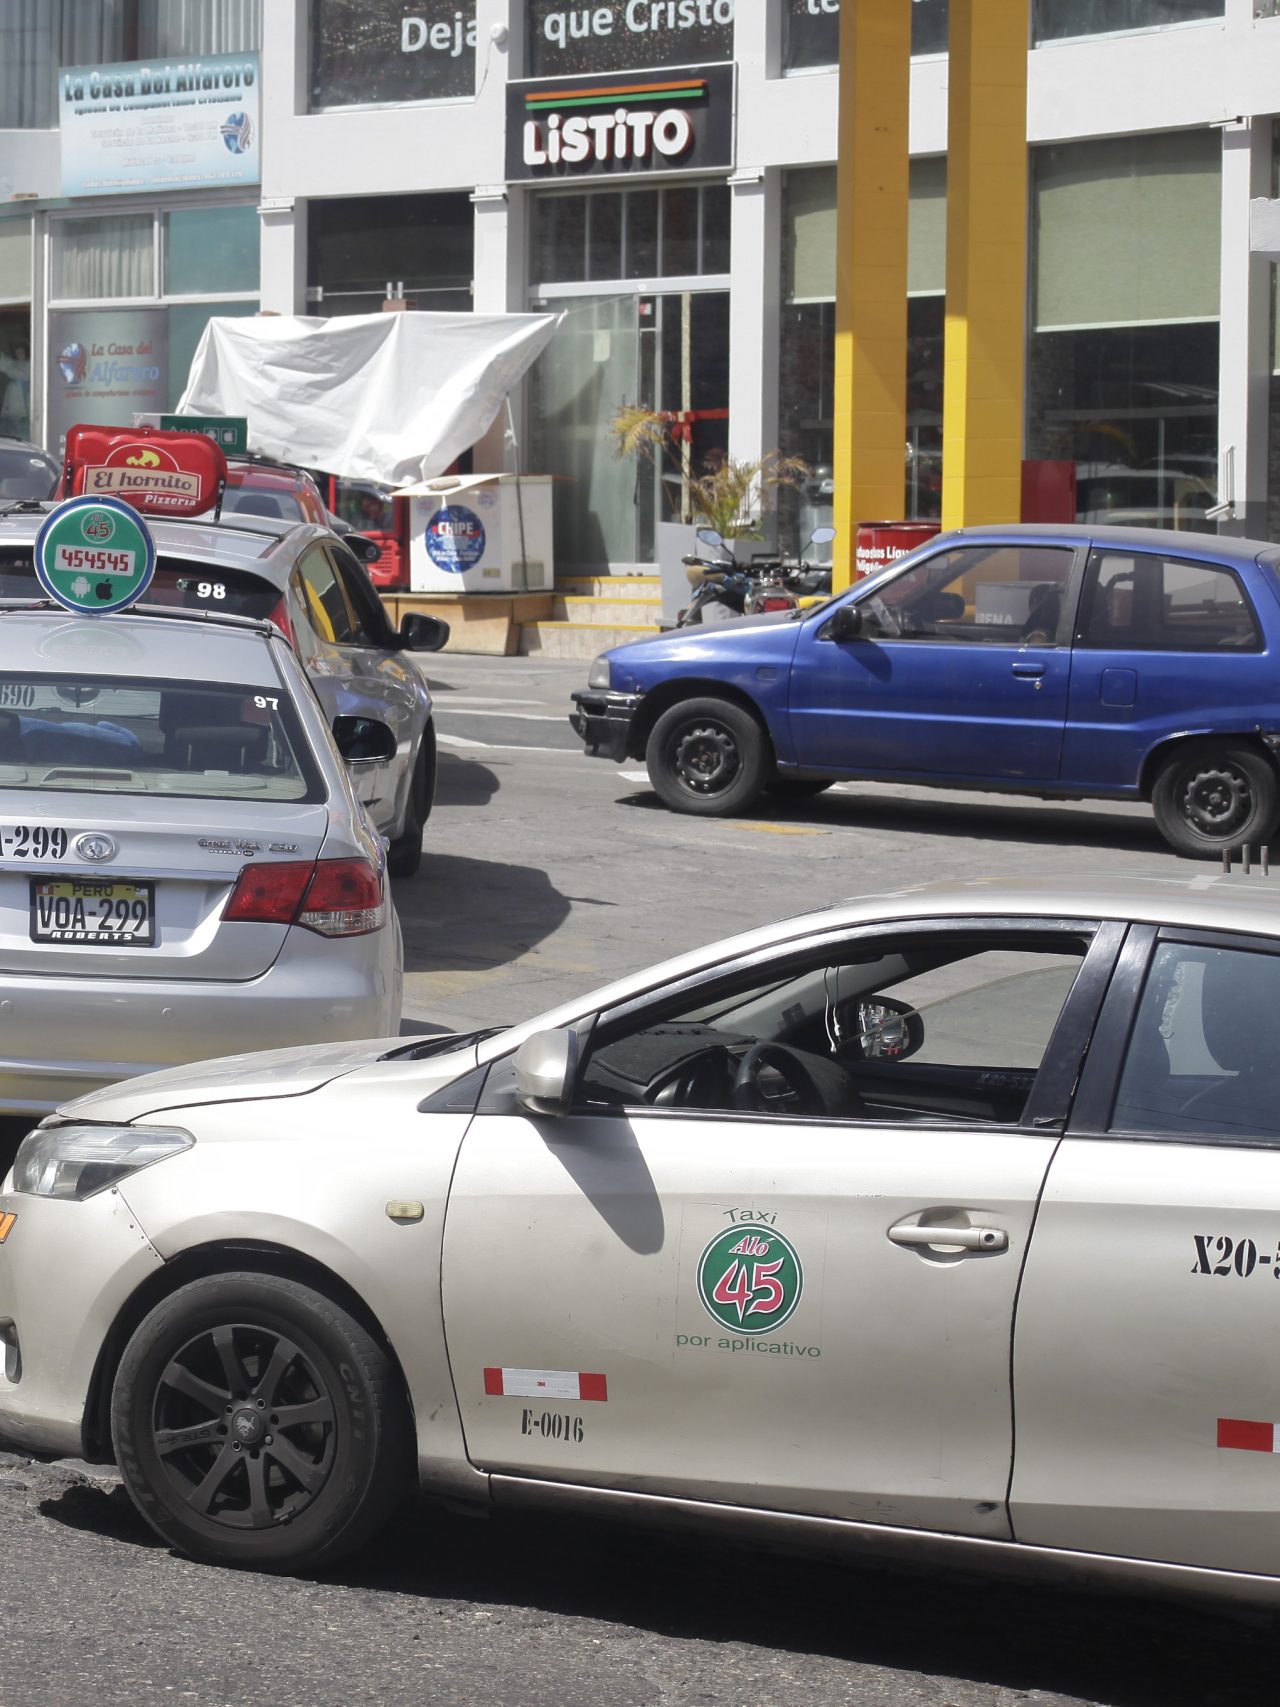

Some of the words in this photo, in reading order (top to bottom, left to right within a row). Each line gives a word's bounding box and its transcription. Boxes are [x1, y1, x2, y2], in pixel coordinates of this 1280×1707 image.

[544, 8, 612, 48] que
[64, 75, 84, 101] La
[90, 72, 135, 98] Casa
[140, 67, 170, 94] Del
[176, 64, 255, 92] Alfarero
[91, 344, 104, 357] La
[107, 343, 134, 356] Casa
[94, 471, 112, 488] El
[119, 471, 192, 491] hornito
[144, 494, 197, 507] Pizzeria
[86, 522, 110, 538] 45
[61, 548, 129, 572] 454545
[196, 582, 226, 600] 98
[253, 695, 279, 711] 97
[37, 896, 147, 932] VOA-299
[51, 930, 133, 941] ROBERTS
[723, 1207, 778, 1225] Taxi
[729, 1235, 776, 1257] Aló
[713, 1257, 785, 1324] 45
[676, 1334, 711, 1347] por
[718, 1338, 821, 1358] aplicativo
[521, 1409, 584, 1443] E-0016
